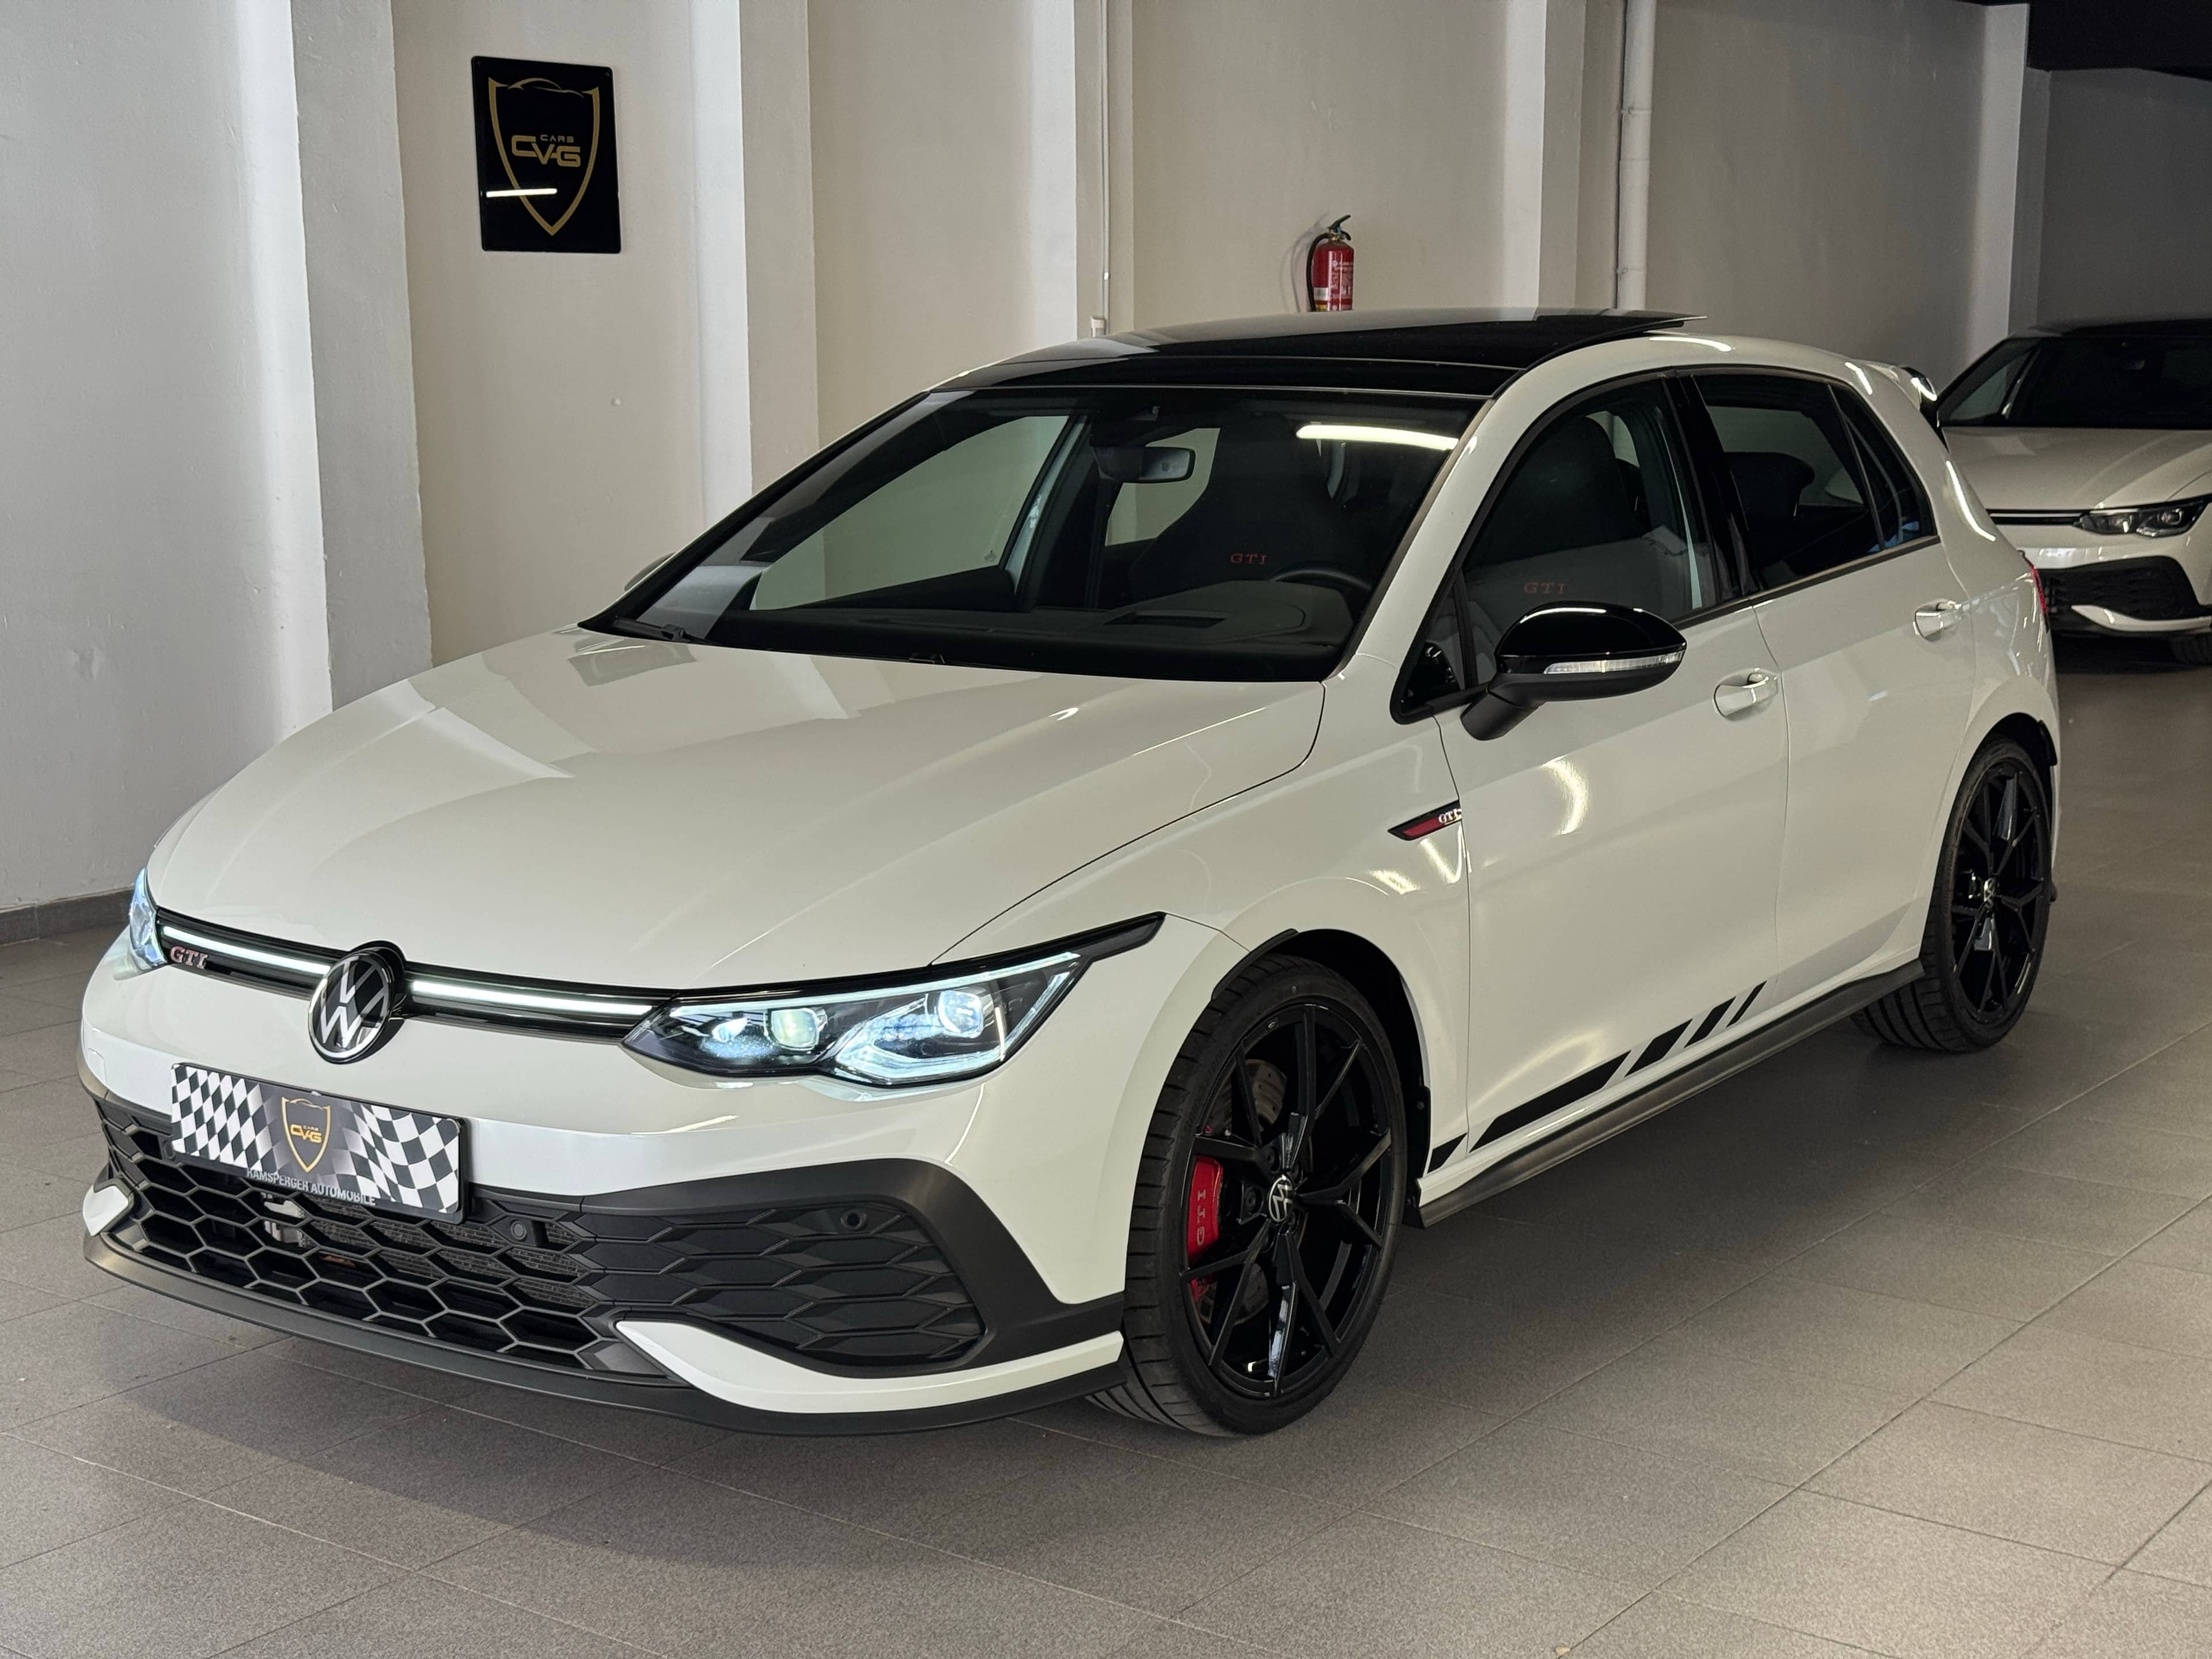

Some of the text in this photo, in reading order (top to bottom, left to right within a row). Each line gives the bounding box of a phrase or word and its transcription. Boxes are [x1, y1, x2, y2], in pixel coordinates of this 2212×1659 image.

[540, 134, 574, 143] CARS
[1230, 553, 1267, 565] GTI
[1524, 581, 1566, 594] GTI
[170, 946, 209, 970] GTI
[1196, 1189, 1206, 1246] GTI
